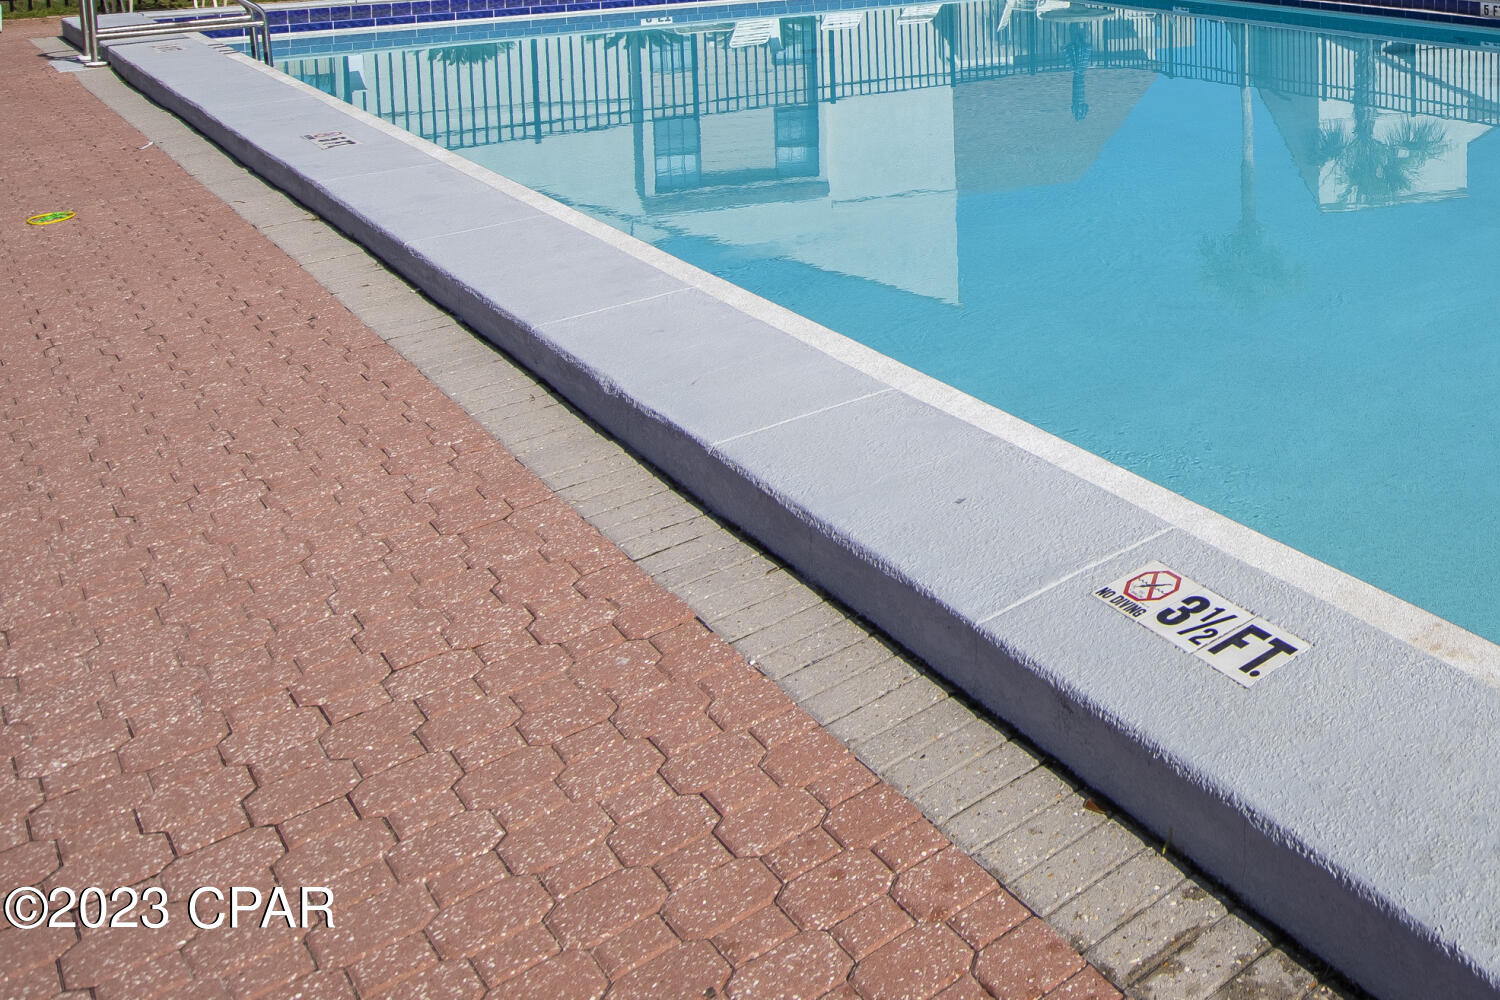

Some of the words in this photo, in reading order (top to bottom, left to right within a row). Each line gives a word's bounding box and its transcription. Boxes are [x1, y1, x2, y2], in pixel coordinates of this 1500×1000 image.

[1484, 5, 1489, 15] 5
[1095, 586, 1116, 598] NO
[1109, 594, 1147, 618] DIVING
